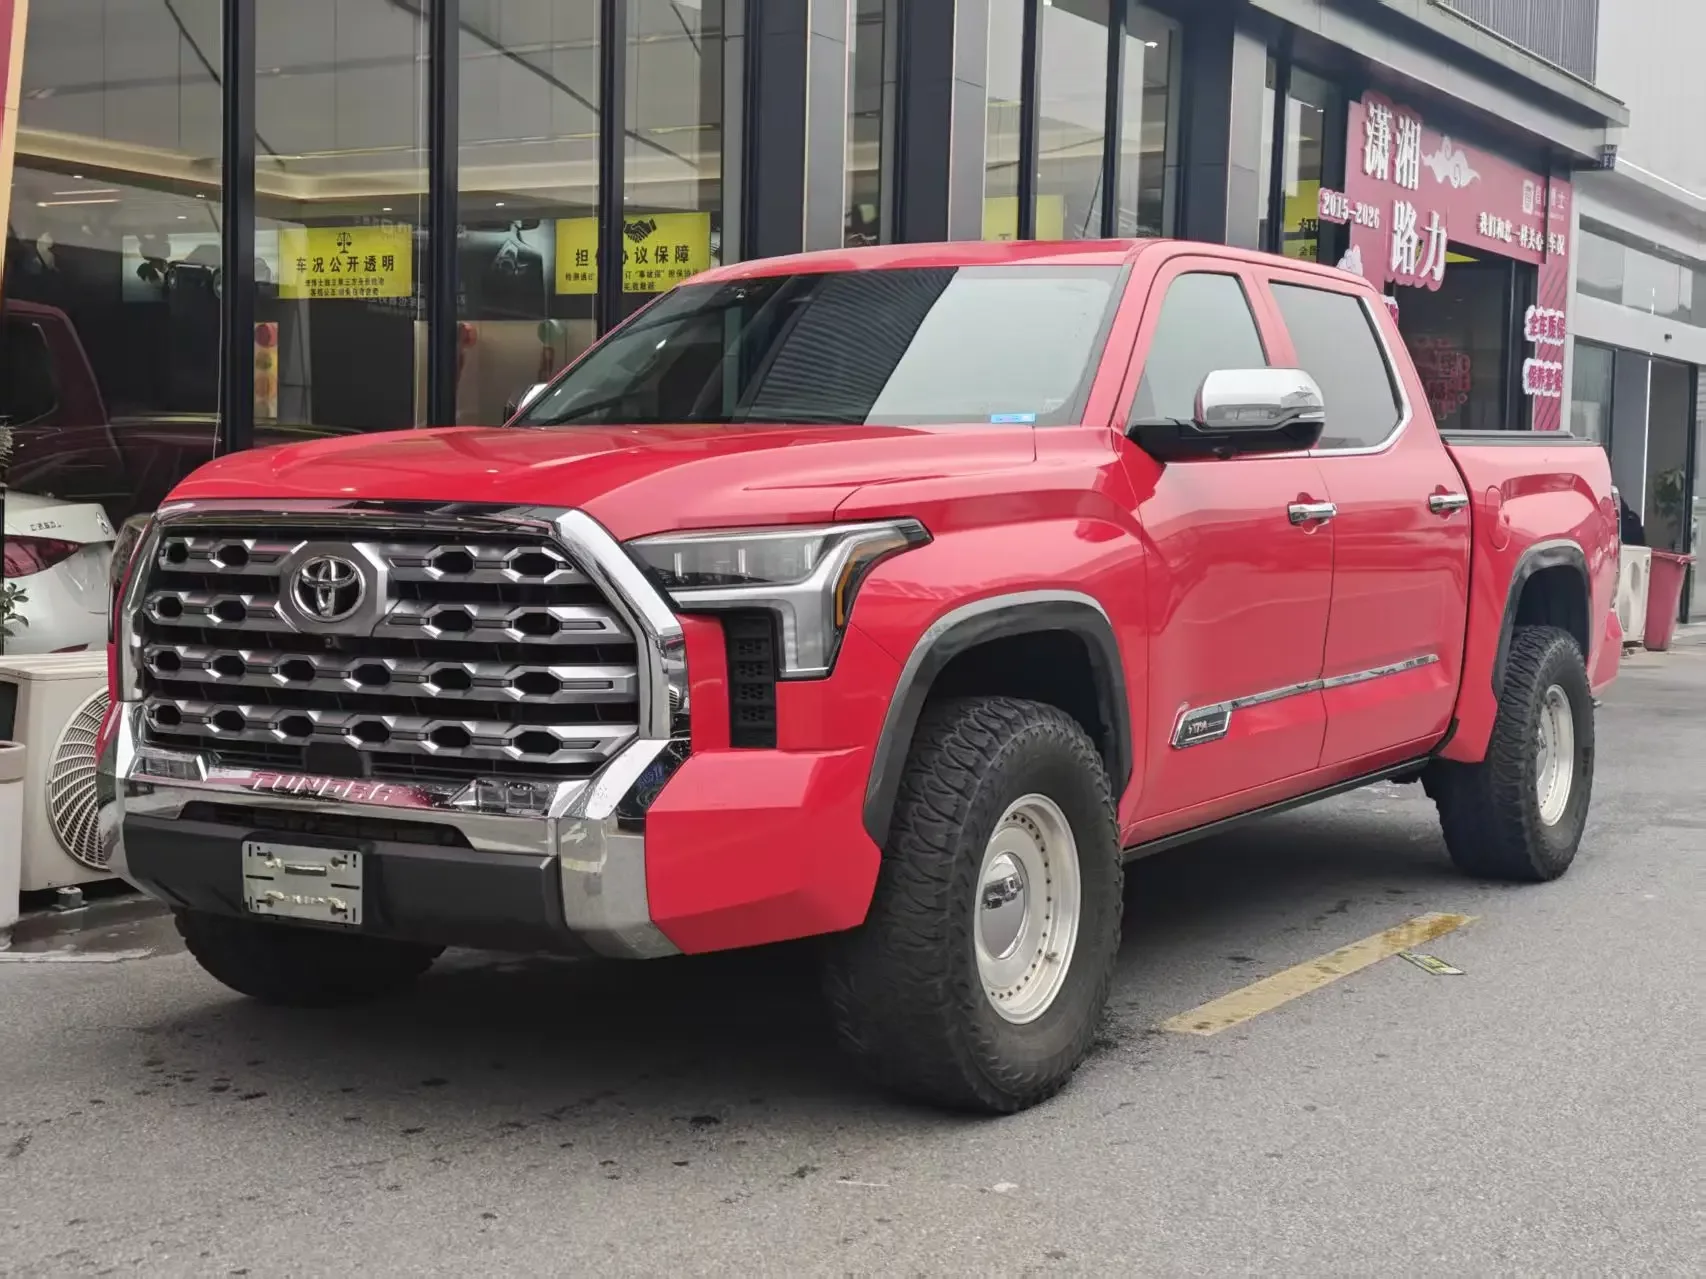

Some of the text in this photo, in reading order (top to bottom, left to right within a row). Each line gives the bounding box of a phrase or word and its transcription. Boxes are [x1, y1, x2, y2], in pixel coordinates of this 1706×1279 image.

[1364, 102, 1422, 190] 潇湘
[295, 255, 395, 273] 车况公开透明
[1391, 201, 1448, 282] 路力
